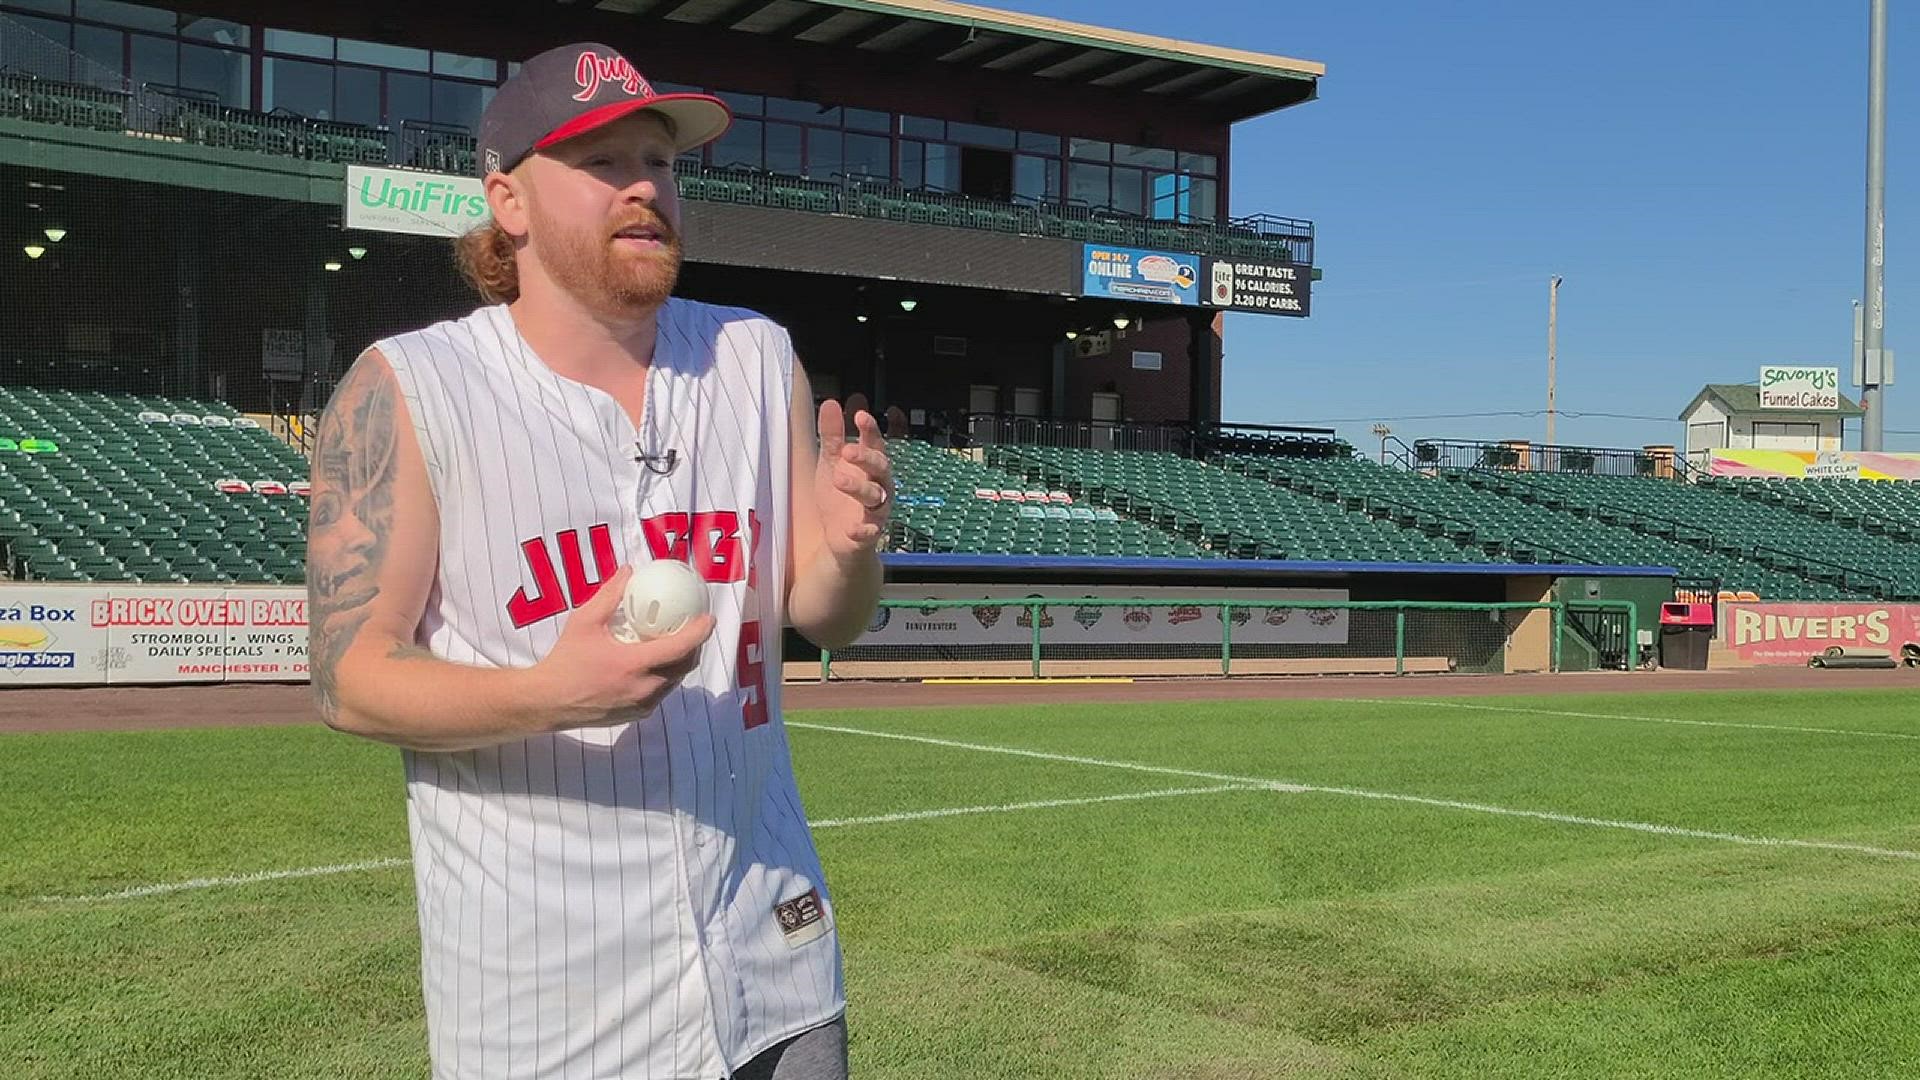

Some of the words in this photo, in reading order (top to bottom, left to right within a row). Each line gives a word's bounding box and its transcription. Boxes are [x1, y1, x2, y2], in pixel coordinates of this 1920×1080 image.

[360, 175, 488, 217] UniFirs
[1089, 261, 1133, 279] ONLINE
[1235, 263, 1265, 277] GREAT
[1266, 266, 1297, 280] TASTE.
[1235, 279, 1247, 290] 96
[1248, 280, 1294, 295] CALORIES.
[1256, 296, 1268, 308] OF
[1762, 369, 1836, 390] Savory's
[1762, 391, 1800, 406] Funnel
[1801, 391, 1837, 407] Cakes
[1806, 466, 1832, 474] WHITE
[506, 508, 760, 630] JUGG
[31, 604, 76, 621] Box
[91, 598, 173, 627] BRICK
[178, 599, 245, 626] OVEN
[1735, 608, 1890, 647] RIVER'S
[131, 633, 218, 645] STROMBOLI
[247, 633, 294, 644] WINGS
[149, 646, 191, 657] DAILY
[197, 646, 264, 657] SPECIALS
[33, 652, 71, 668] Shop
[178, 663, 279, 673] MANCHESTER
